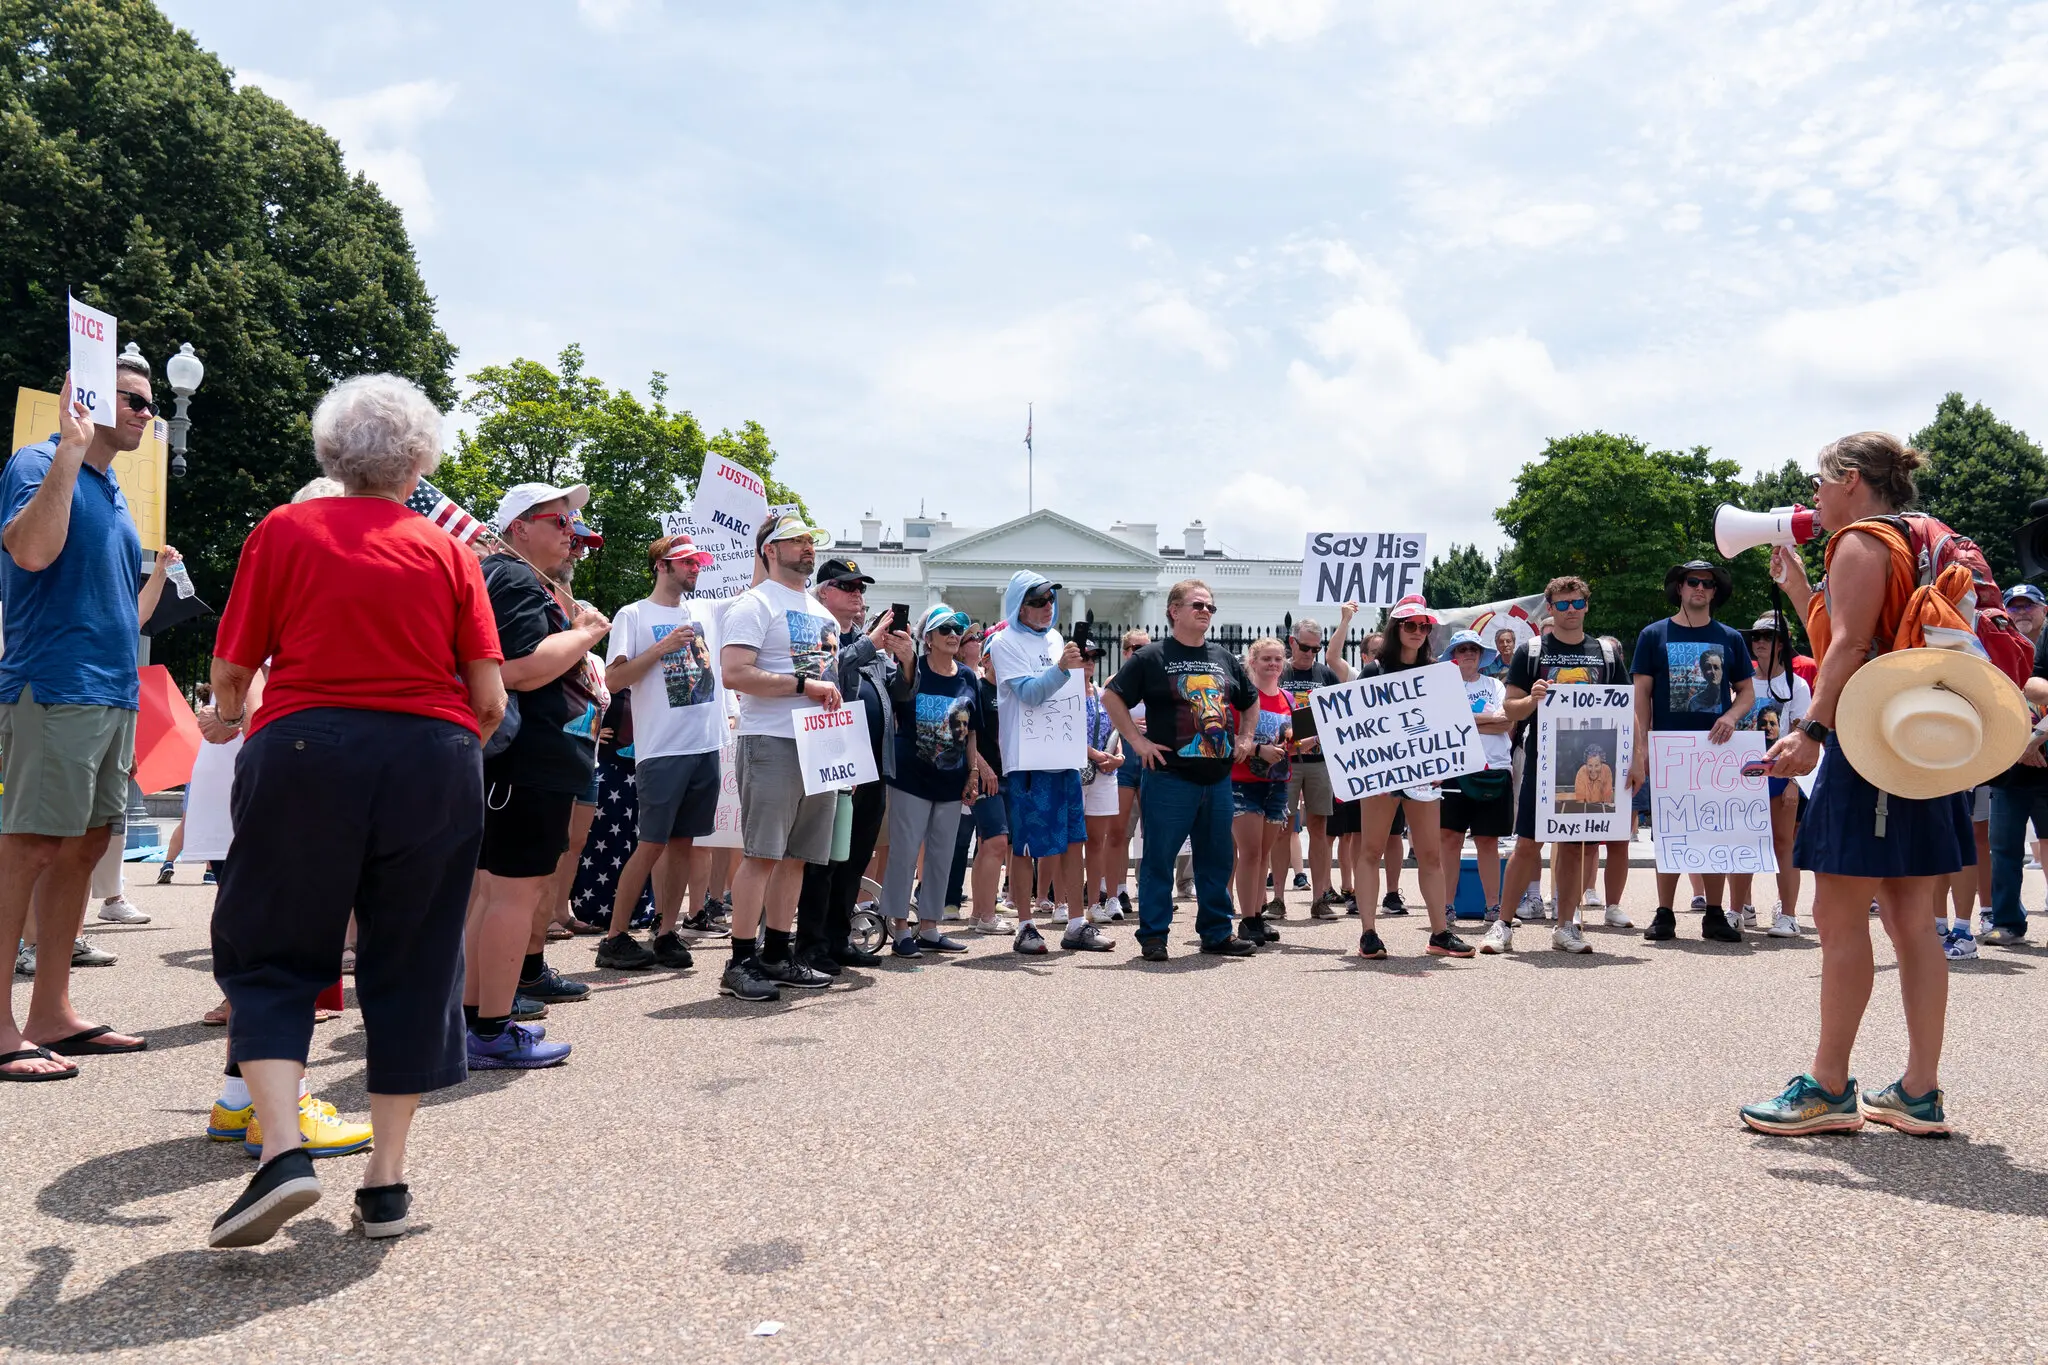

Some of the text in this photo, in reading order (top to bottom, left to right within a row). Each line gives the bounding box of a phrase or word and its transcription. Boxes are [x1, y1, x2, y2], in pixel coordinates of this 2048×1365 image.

[716, 463, 766, 498] JUSTICE
[711, 509, 751, 536] MARC
[1311, 532, 1419, 559] Say His
[846, 561, 856, 572] P
[1316, 675, 1427, 724] MY UNCLE
[1545, 690, 1557, 708] 7
[804, 710, 854, 732] JUSTICE
[1059, 694, 1081, 742] Free
[1335, 708, 1426, 746] MARC IS
[1333, 724, 1472, 774] WRONGFULLY
[1652, 735, 1767, 792] Free
[819, 763, 856, 783] MARC
[1347, 751, 1466, 797] DETAINED!!
[1585, 819, 1610, 833] Held
[1658, 794, 1769, 834] Marc
[1662, 835, 1776, 873] Fogel
